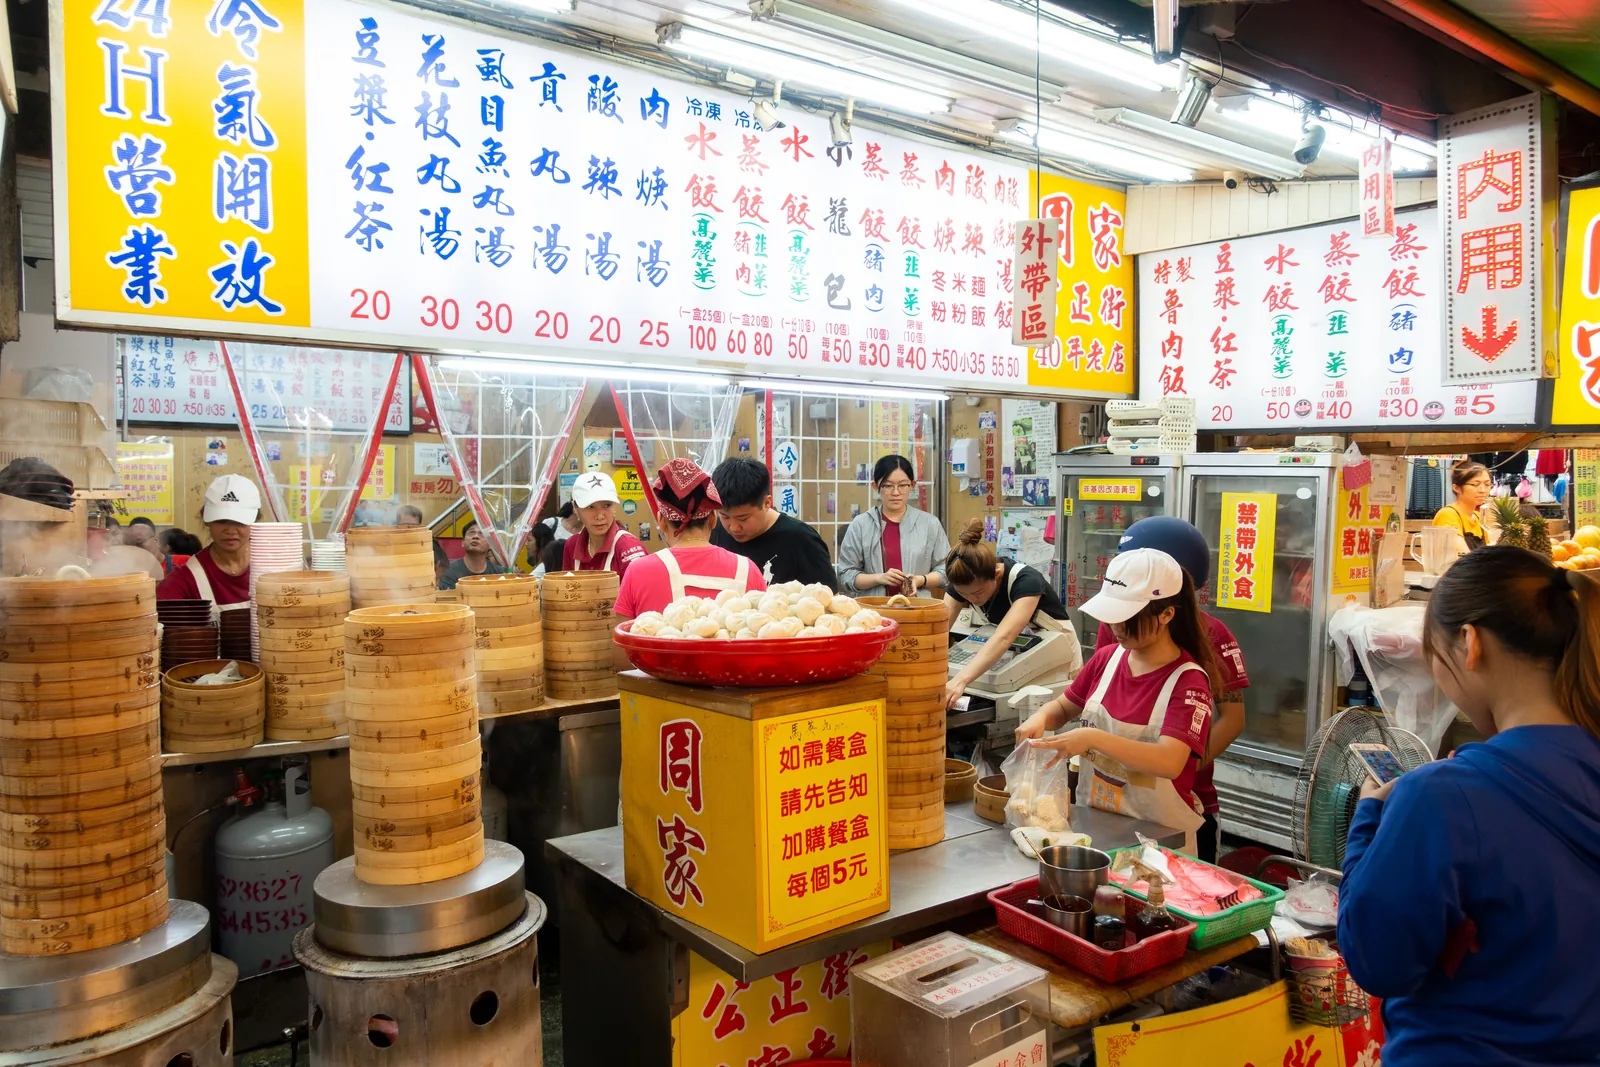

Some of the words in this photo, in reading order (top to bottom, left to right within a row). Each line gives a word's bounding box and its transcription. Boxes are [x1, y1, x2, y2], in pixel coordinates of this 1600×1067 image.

[685, 96, 721, 121] 冷凍
[208, 0, 284, 314] 冷氣開放
[414, 33, 462, 261] 花枝丸湯
[529, 61, 571, 275] 貢丸湯
[581, 74, 624, 281] 酸辣湯
[683, 121, 724, 213] 水餃
[732, 133, 770, 223] 蒸餃
[780, 125, 815, 231] 水餃
[859, 142, 890, 243] 蒸餃
[896, 152, 926, 250] 蒸餃
[823, 145, 852, 311] 小籠包
[1262, 243, 1300, 313] 水餃
[1317, 231, 1360, 304] 蒸餃
[1382, 223, 1428, 300] 蒸餃
[1019, 222, 1053, 341] 外帶區
[349, 287, 391, 320] 20
[420, 295, 460, 330] 30
[475, 300, 513, 334] 30
[534, 309, 569, 340] 20
[589, 315, 621, 344] 20
[639, 319, 670, 348] 25
[688, 324, 717, 352] 100
[727, 329, 747, 354] 60
[754, 331, 773, 356] 80
[788, 334, 808, 360] 50
[833, 338, 852, 364] 50
[868, 343, 890, 368] 30
[905, 347, 926, 371] 40
[1158, 288, 1188, 396] 魯肉飯
[992, 355, 1004, 377] 55
[1007, 357, 1019, 378] 50
[132, 398, 145, 414] 20
[149, 399, 161, 415] 30
[164, 399, 176, 415] 30
[1211, 405, 1233, 422] 20
[1266, 401, 1290, 420] 50
[1326, 401, 1352, 419] 40
[1389, 398, 1419, 418] 30
[1470, 394, 1496, 415] 5
[1083, 485, 1136, 494] 非基因改造黃豆
[1233, 503, 1257, 599] 禁帶外食
[1067, 561, 1077, 607] 小心輕放
[1349, 566, 1373, 580] 謝謝配
[779, 731, 868, 774] 如需餐盒
[780, 773, 868, 817] 請先告知
[658, 720, 706, 906] 周家
[781, 813, 869, 861] 加購餐盒
[787, 852, 868, 898] 每個5元
[702, 953, 869, 1039] 公正街
